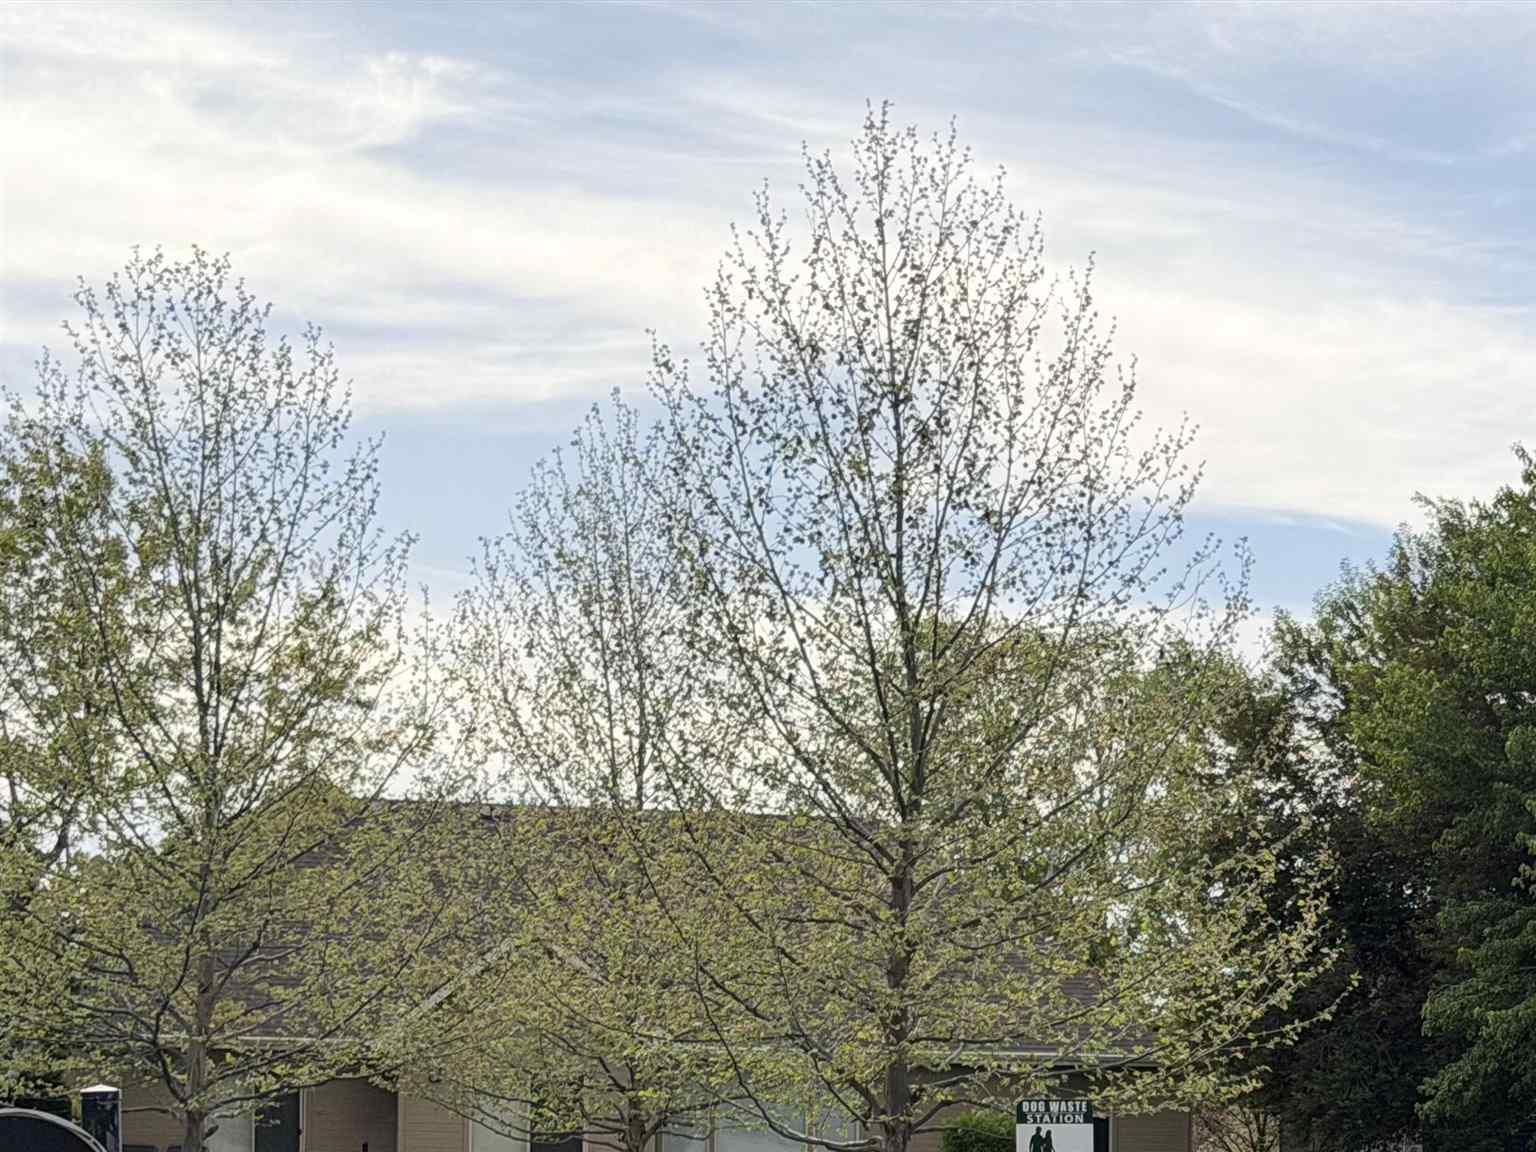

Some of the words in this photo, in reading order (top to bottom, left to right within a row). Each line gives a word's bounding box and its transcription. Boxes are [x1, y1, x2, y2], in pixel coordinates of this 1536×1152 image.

[1022, 1101, 1045, 1112] DOG
[1048, 1101, 1088, 1112] WASTE
[1026, 1114, 1084, 1124] STATION
